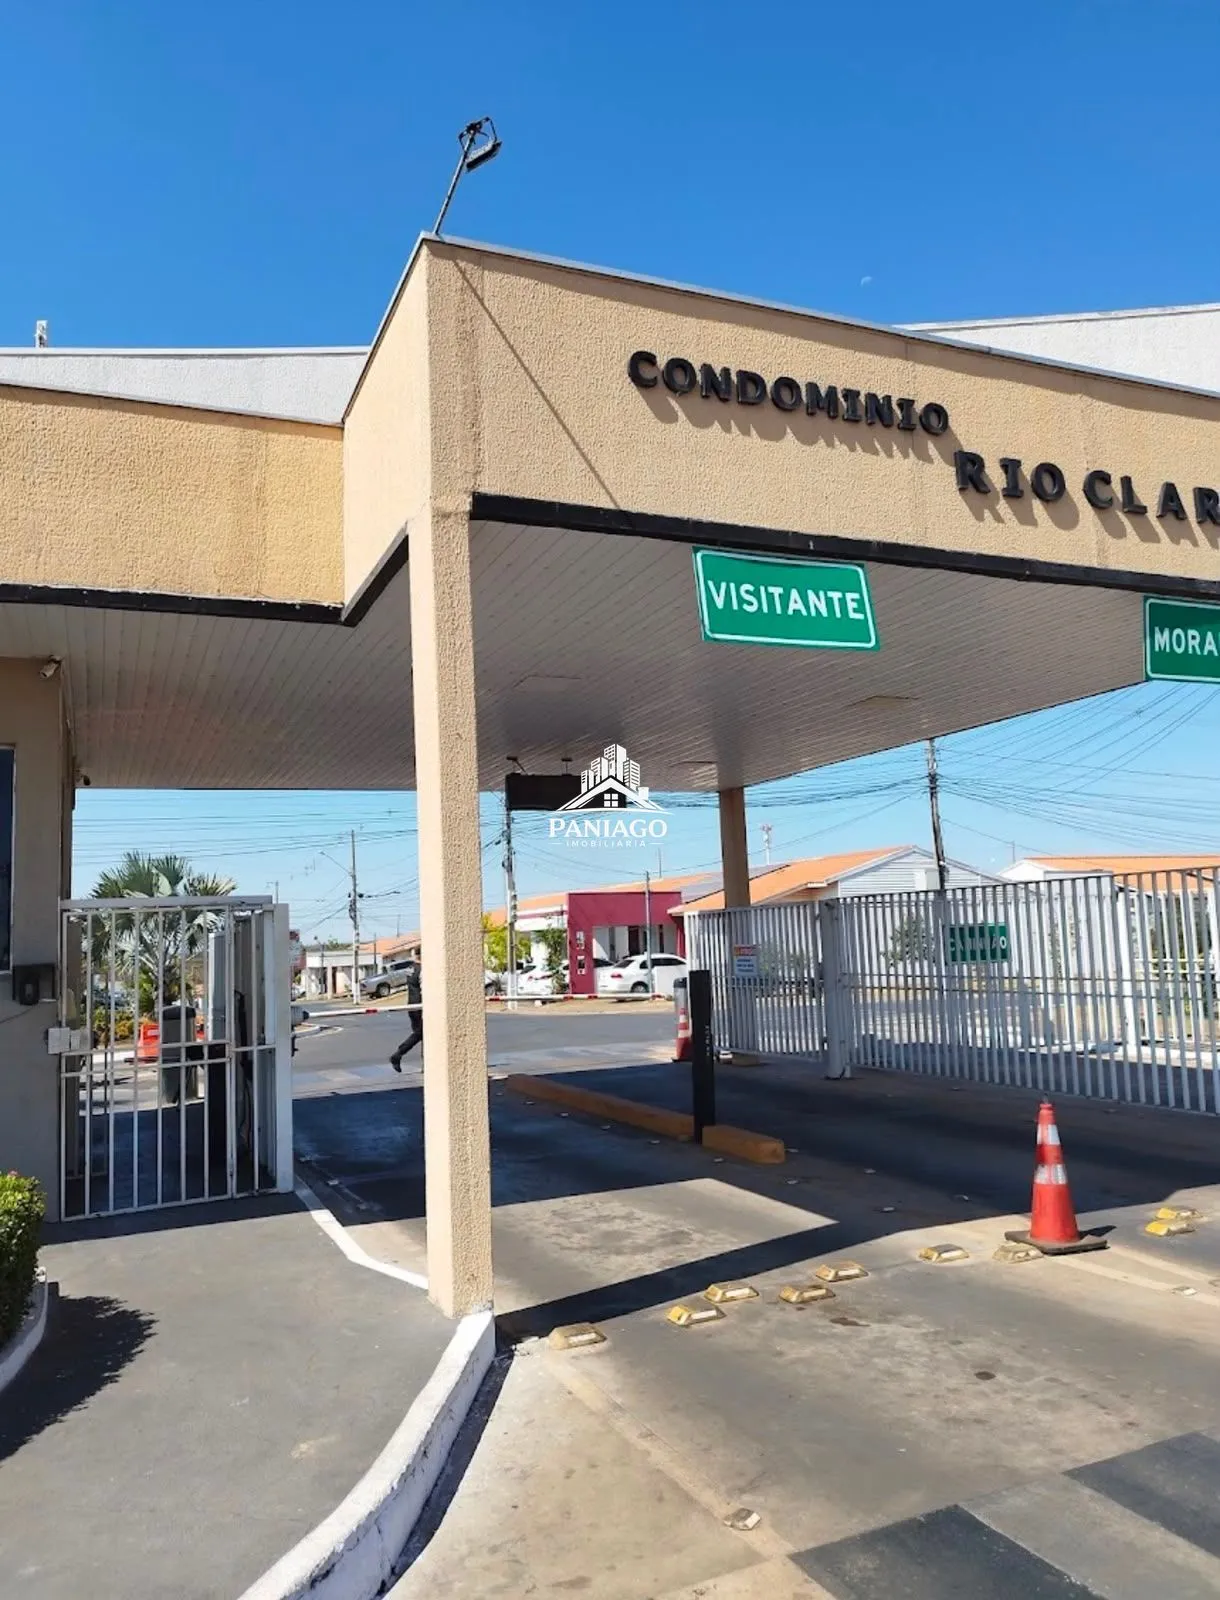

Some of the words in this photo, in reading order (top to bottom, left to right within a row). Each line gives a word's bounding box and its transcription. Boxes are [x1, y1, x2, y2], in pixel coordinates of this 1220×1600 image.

[628, 351, 949, 436] CONDOMINIO
[954, 450, 1066, 502] RIO
[707, 579, 865, 620] VISITANTE
[1153, 626, 1220, 657] MORA
